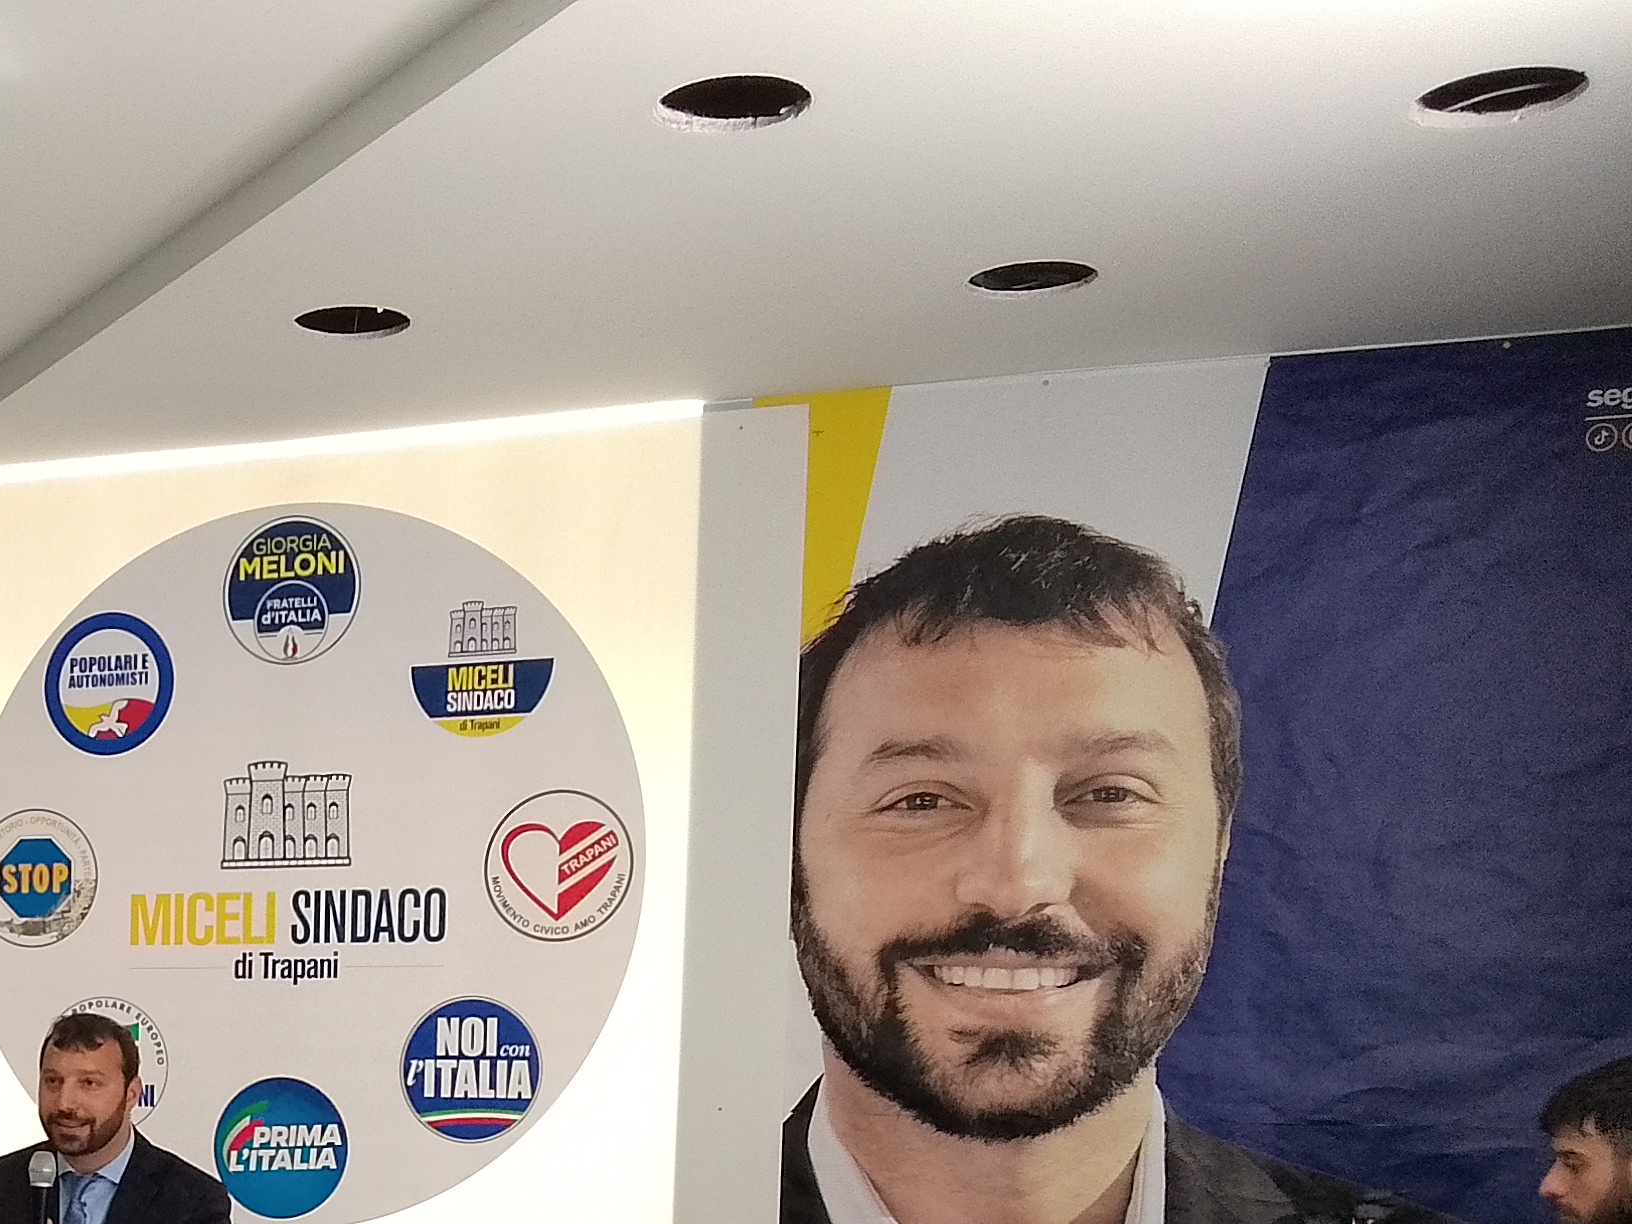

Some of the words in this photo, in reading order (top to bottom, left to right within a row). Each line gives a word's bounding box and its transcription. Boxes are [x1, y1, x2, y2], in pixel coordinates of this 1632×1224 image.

[252, 533, 332, 555] GIORGIA
[239, 550, 345, 581] MELONI
[261, 609, 322, 625] d'ITALIA
[266, 597, 317, 610] FRATELLI
[70, 654, 138, 673] POPOLARI
[141, 652, 149, 670] E
[68, 671, 149, 689] AUTONOMISTI
[448, 663, 514, 691] MICELI
[446, 689, 515, 712] SINDACO
[459, 719, 467, 731] di
[470, 718, 500, 733] Trapani
[560, 834, 617, 876] TRAPANI
[2, 862, 69, 894] STOP
[130, 891, 277, 946] MICELI
[291, 887, 447, 945] SINDACO
[491, 875, 530, 928] MOVIMENTO
[533, 923, 570, 936] CIVICO
[573, 914, 596, 932] AMO
[596, 872, 626, 915] TRAPANI
[234, 953, 253, 979] di
[259, 951, 338, 985] Trapani
[134, 1012, 165, 1066] EUROPEO
[436, 1016, 498, 1057] NOI
[499, 1044, 531, 1058] con
[406, 1058, 532, 1100] l'ITALIA
[252, 1123, 342, 1148] PRIMA
[229, 1147, 338, 1173] L'ITALIA
